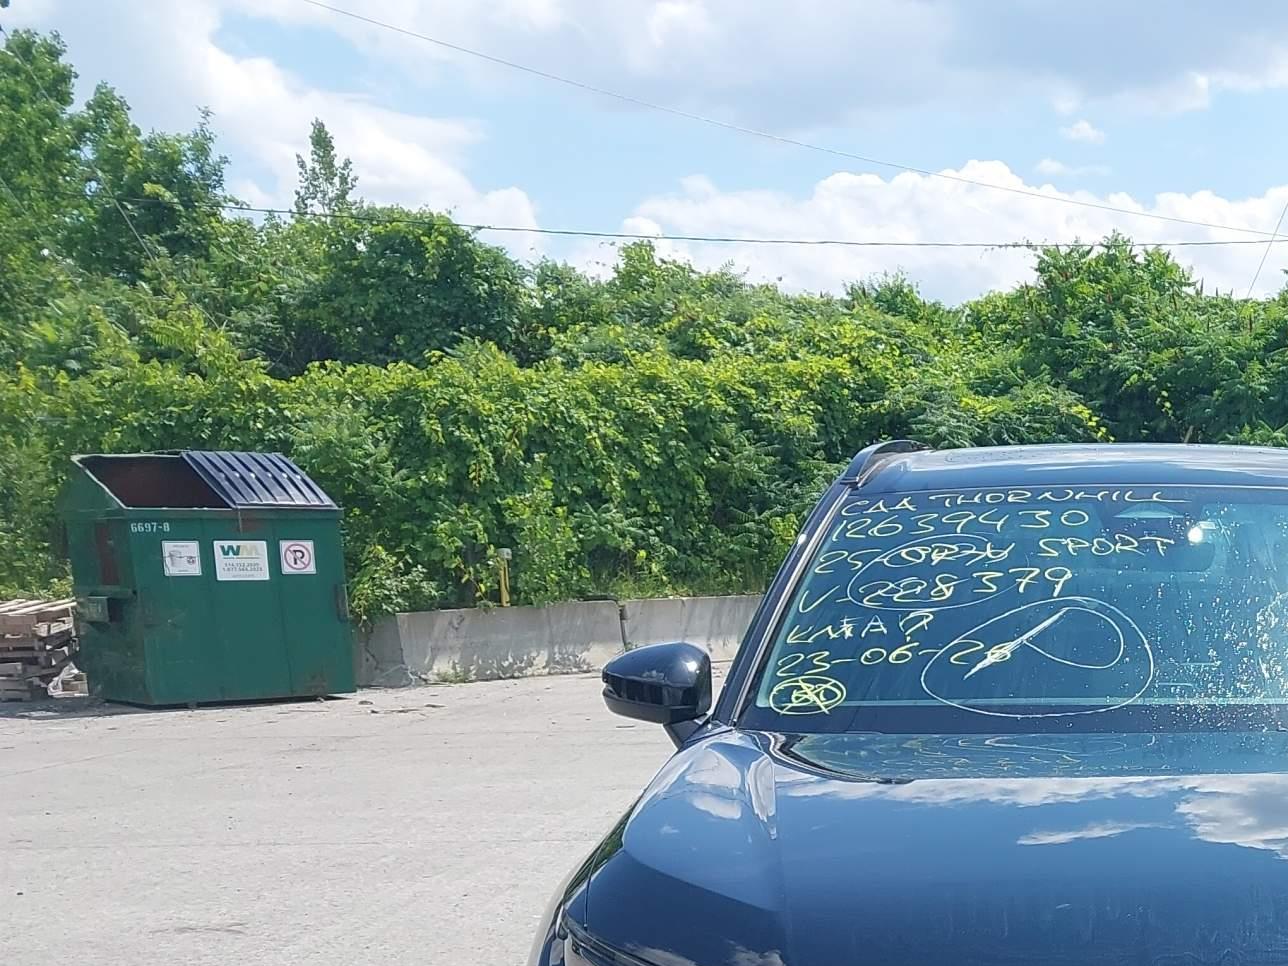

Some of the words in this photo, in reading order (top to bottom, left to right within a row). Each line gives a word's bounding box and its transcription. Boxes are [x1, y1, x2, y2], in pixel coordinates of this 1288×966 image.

[841, 496, 918, 516] CAA
[928, 488, 1192, 507] THORNHILL
[832, 508, 1089, 541] 12639430
[1037, 533, 1175, 556] SPORT
